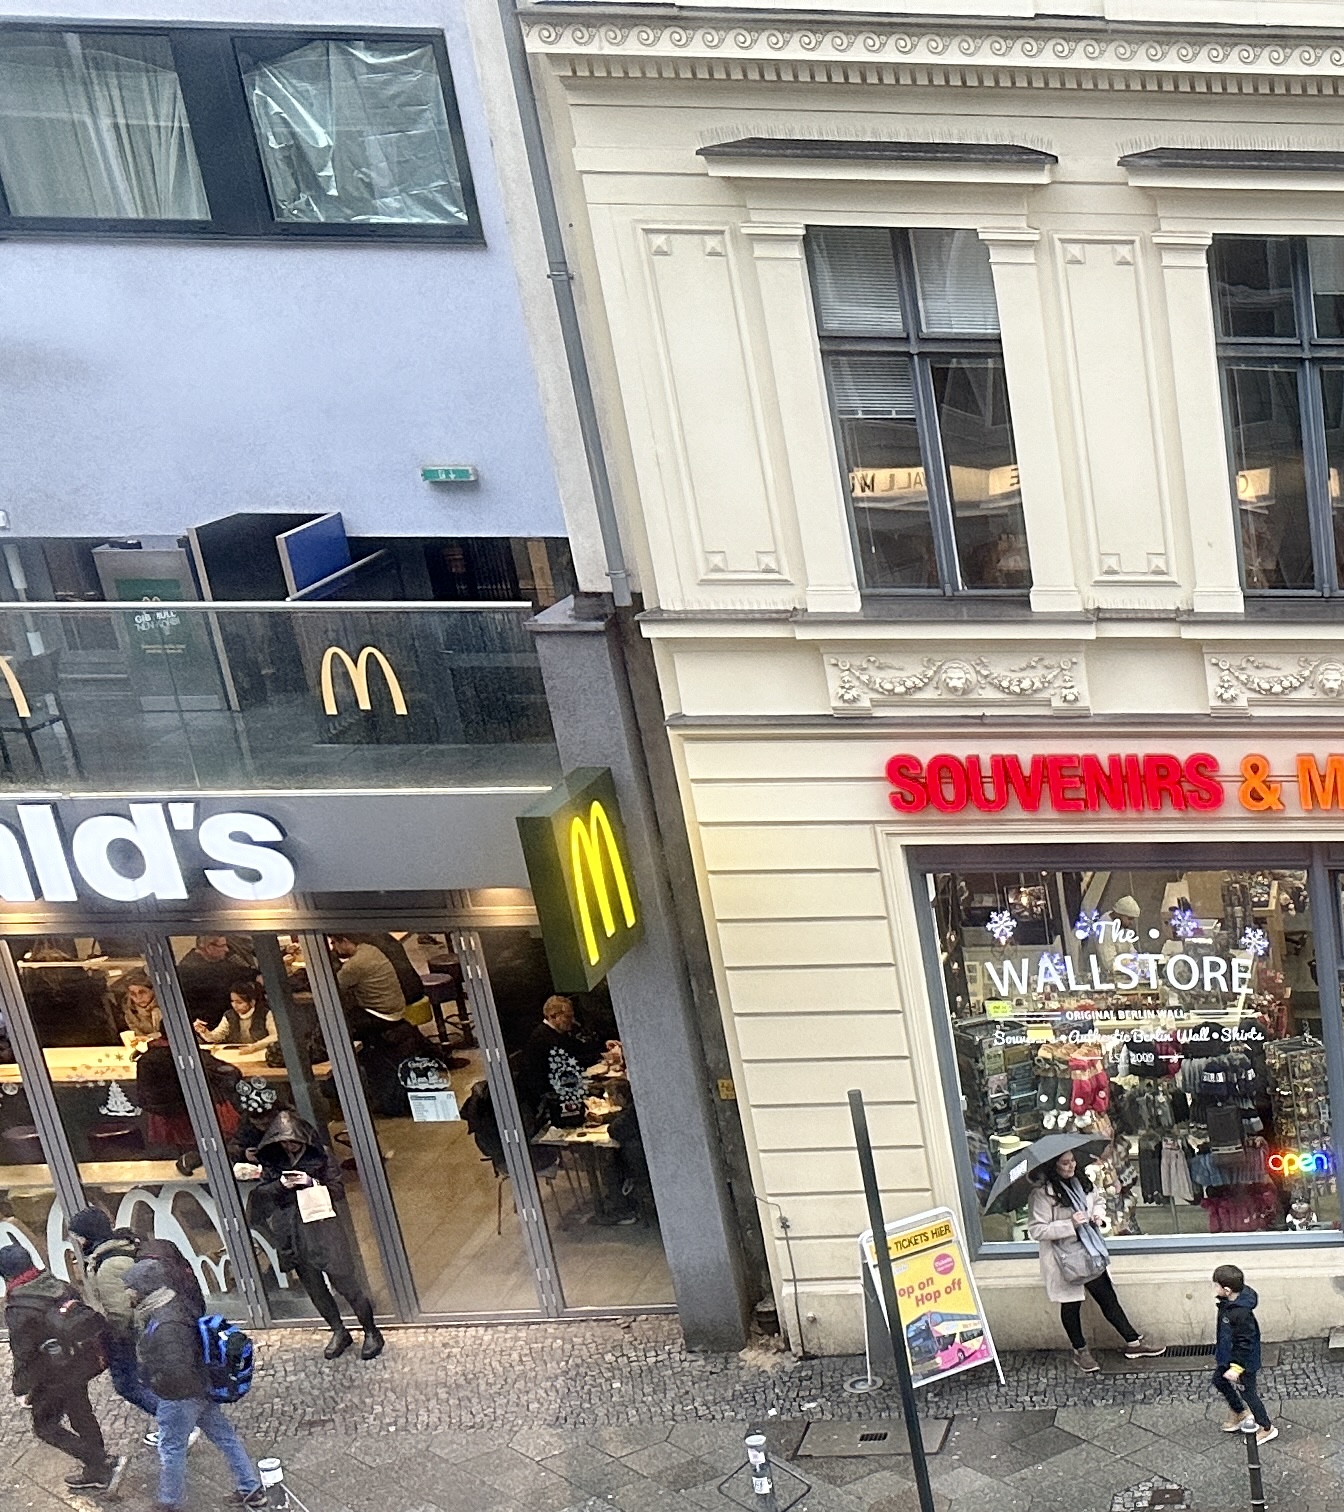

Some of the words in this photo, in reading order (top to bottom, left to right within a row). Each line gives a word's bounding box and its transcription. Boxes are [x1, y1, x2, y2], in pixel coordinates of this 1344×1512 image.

[885, 753, 1225, 813] SOUVENIRS
[1239, 753, 1286, 812] &
[1096, 918, 1139, 944] The
[985, 953, 1254, 997] WALLSTORE
[1066, 1010, 1116, 1021] ORIGINAL
[1119, 1009, 1155, 1020] BERLIN
[1156, 1010, 1185, 1019] WALL
[1133, 1029, 1171, 1043] Berlin
[1177, 1028, 1210, 1043] Wall
[1220, 1027, 1264, 1042] Shirts
[1268, 1153, 1328, 1178] open
[894, 1232, 929, 1252] TICKETS
[898, 1284, 914, 1298] op
[918, 1277, 935, 1291] on
[915, 1290, 941, 1307] Hop
[944, 1277, 963, 1295] off
